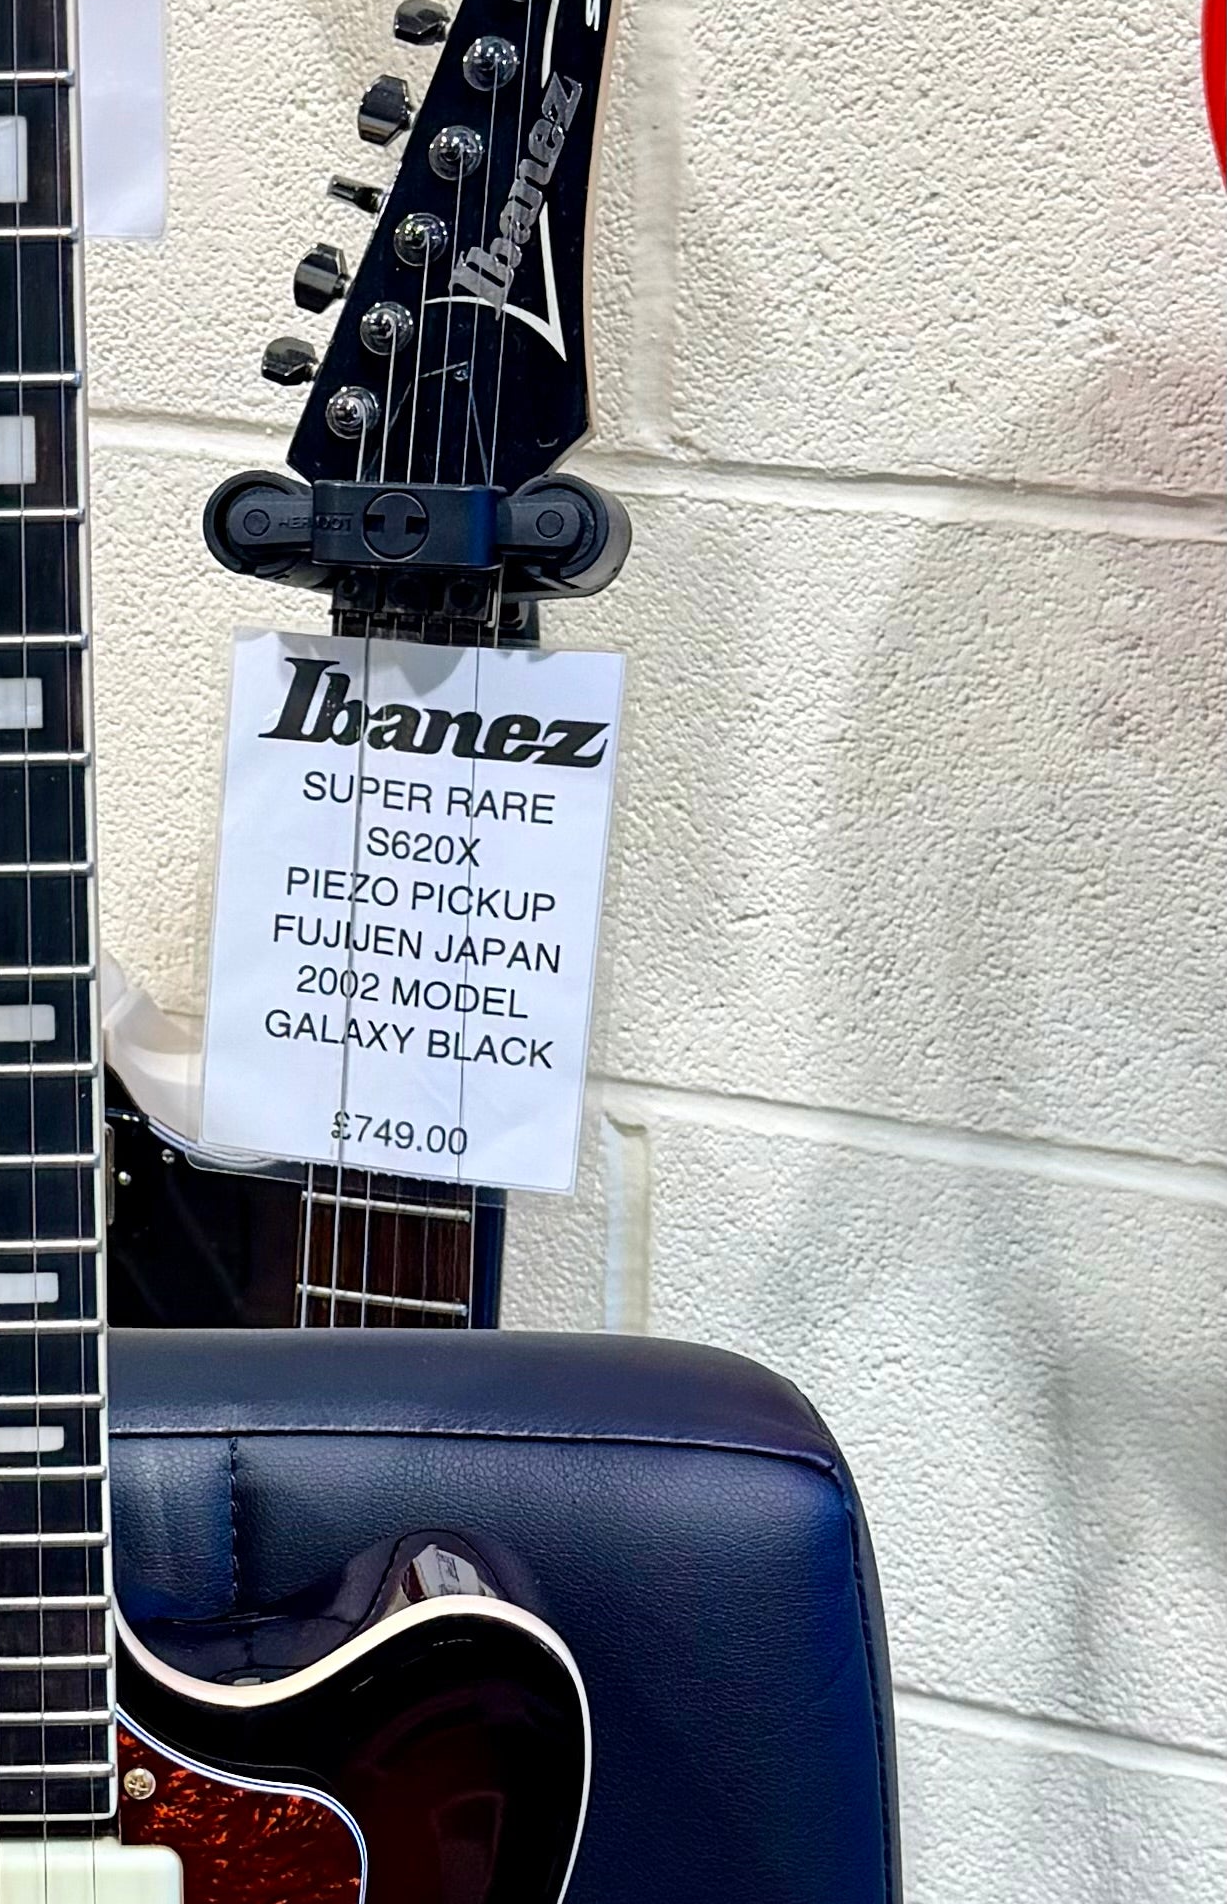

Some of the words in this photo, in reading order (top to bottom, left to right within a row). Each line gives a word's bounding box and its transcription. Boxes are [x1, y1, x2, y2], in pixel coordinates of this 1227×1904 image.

[448, 70, 583, 321] Ibanez
[258, 657, 611, 768] Ibanez
[303, 771, 432, 814] SUPER
[446, 786, 556, 825] RARE
[366, 827, 482, 867] S620X
[286, 866, 399, 907] PIEZO
[411, 881, 556, 922] PICKUP
[273, 914, 422, 959] FUJIJEN
[435, 934, 561, 973] JAPAN
[296, 965, 380, 1002] 2002
[391, 976, 529, 1019] MODEL
[265, 1009, 415, 1054] GALAXY
[427, 1029, 554, 1069] BLACK
[330, 1111, 468, 1155] £749.00
